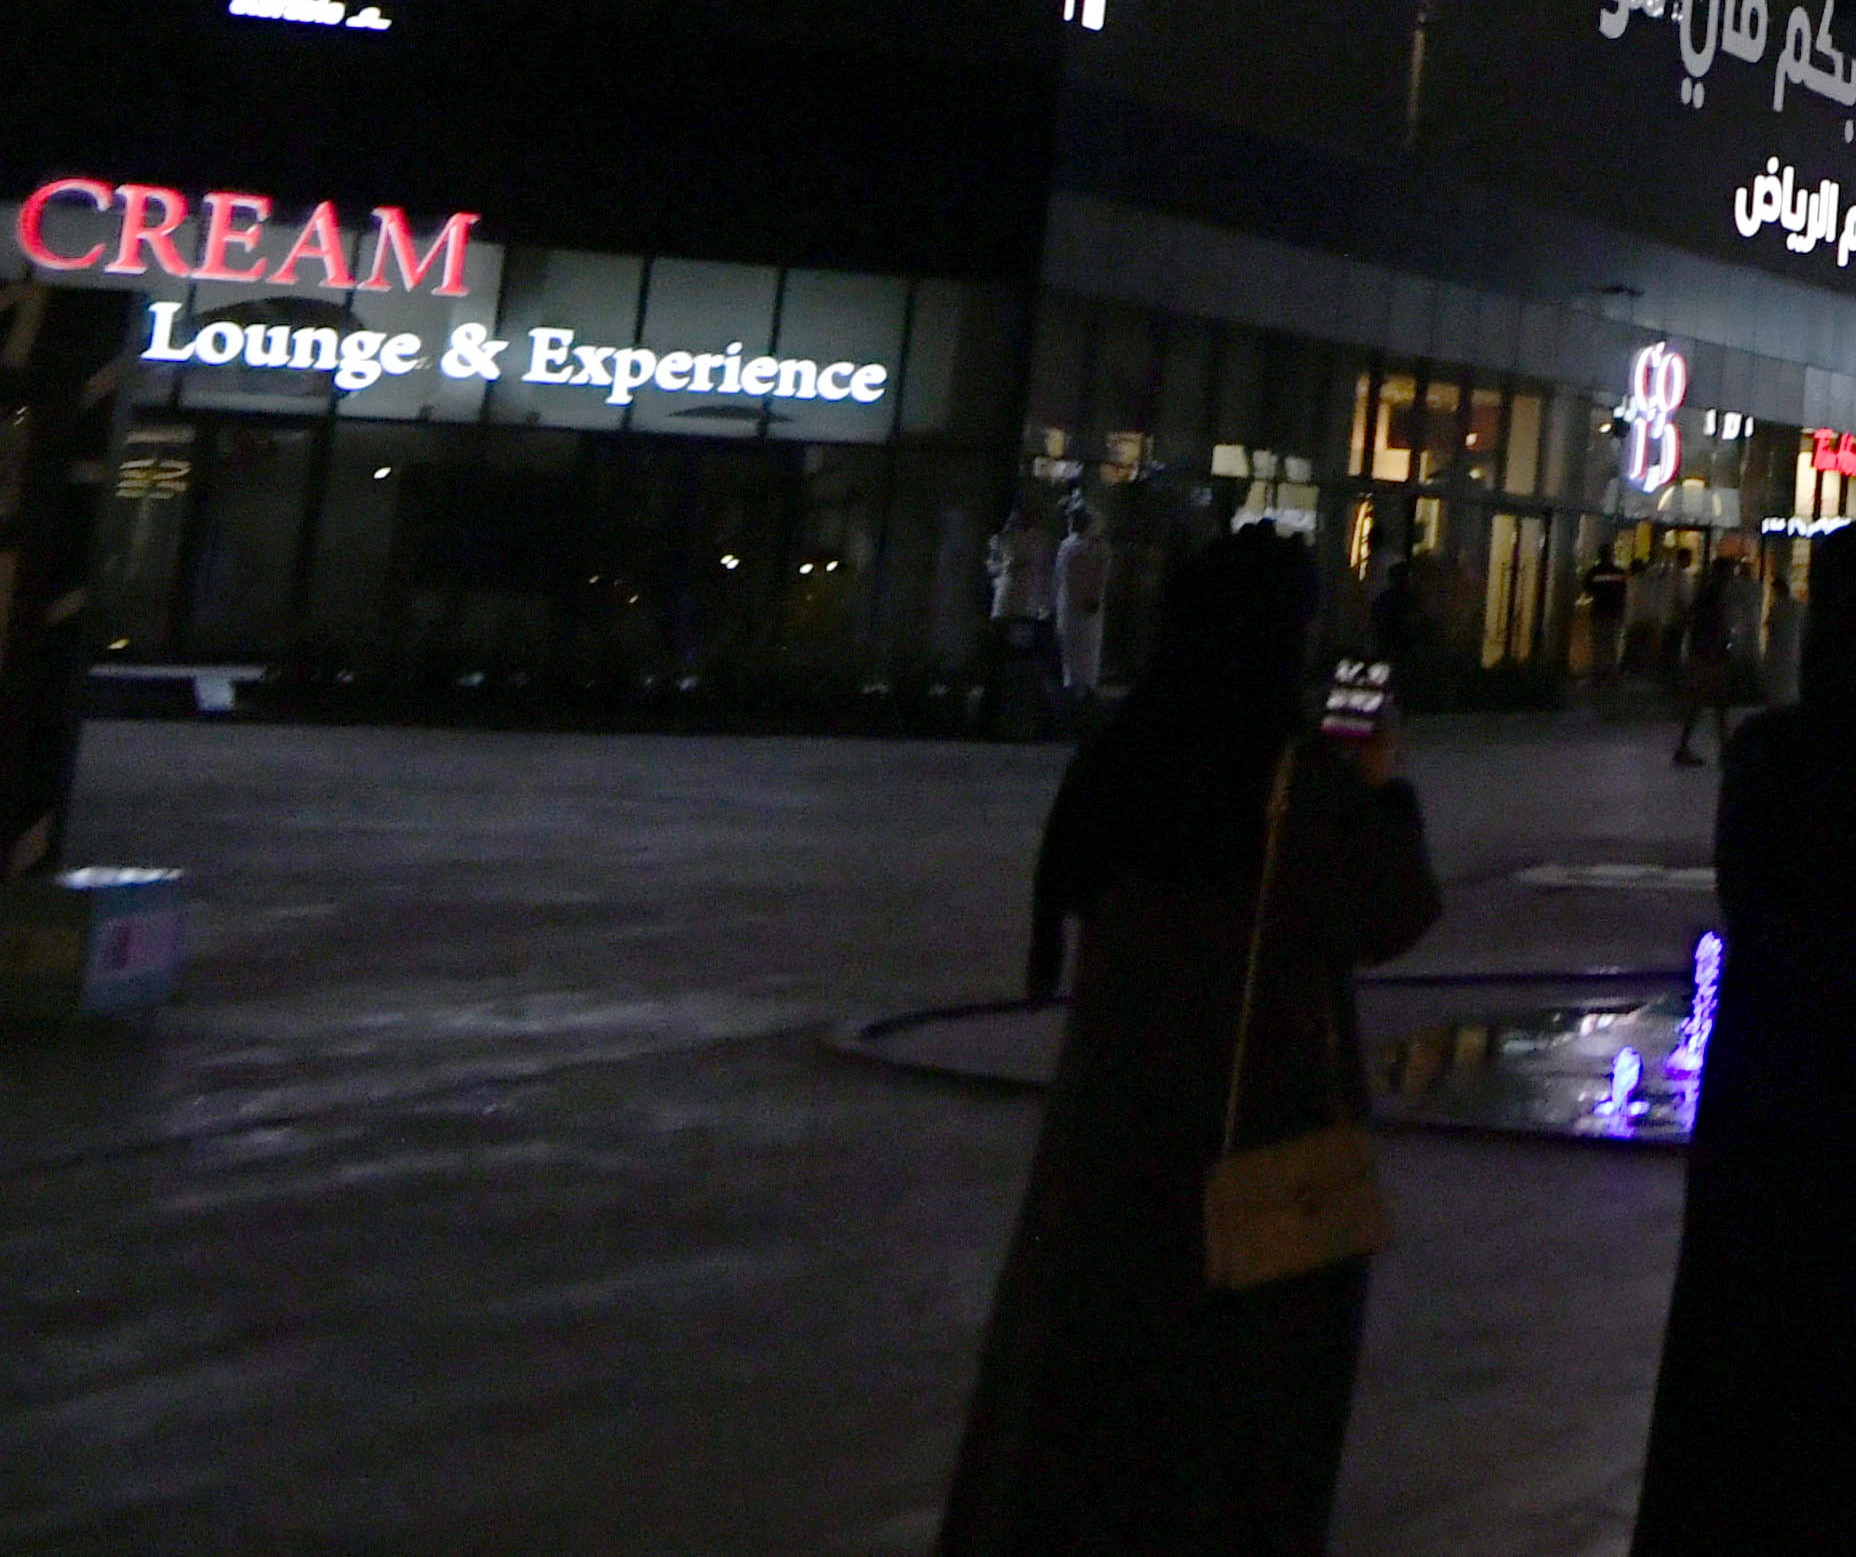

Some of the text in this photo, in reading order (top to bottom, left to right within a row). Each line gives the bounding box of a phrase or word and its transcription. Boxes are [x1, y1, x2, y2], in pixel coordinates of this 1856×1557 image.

[17, 177, 481, 297] CREAM
[1734, 156, 1840, 253] الرياض
[141, 301, 887, 406] Lounge & Experience
